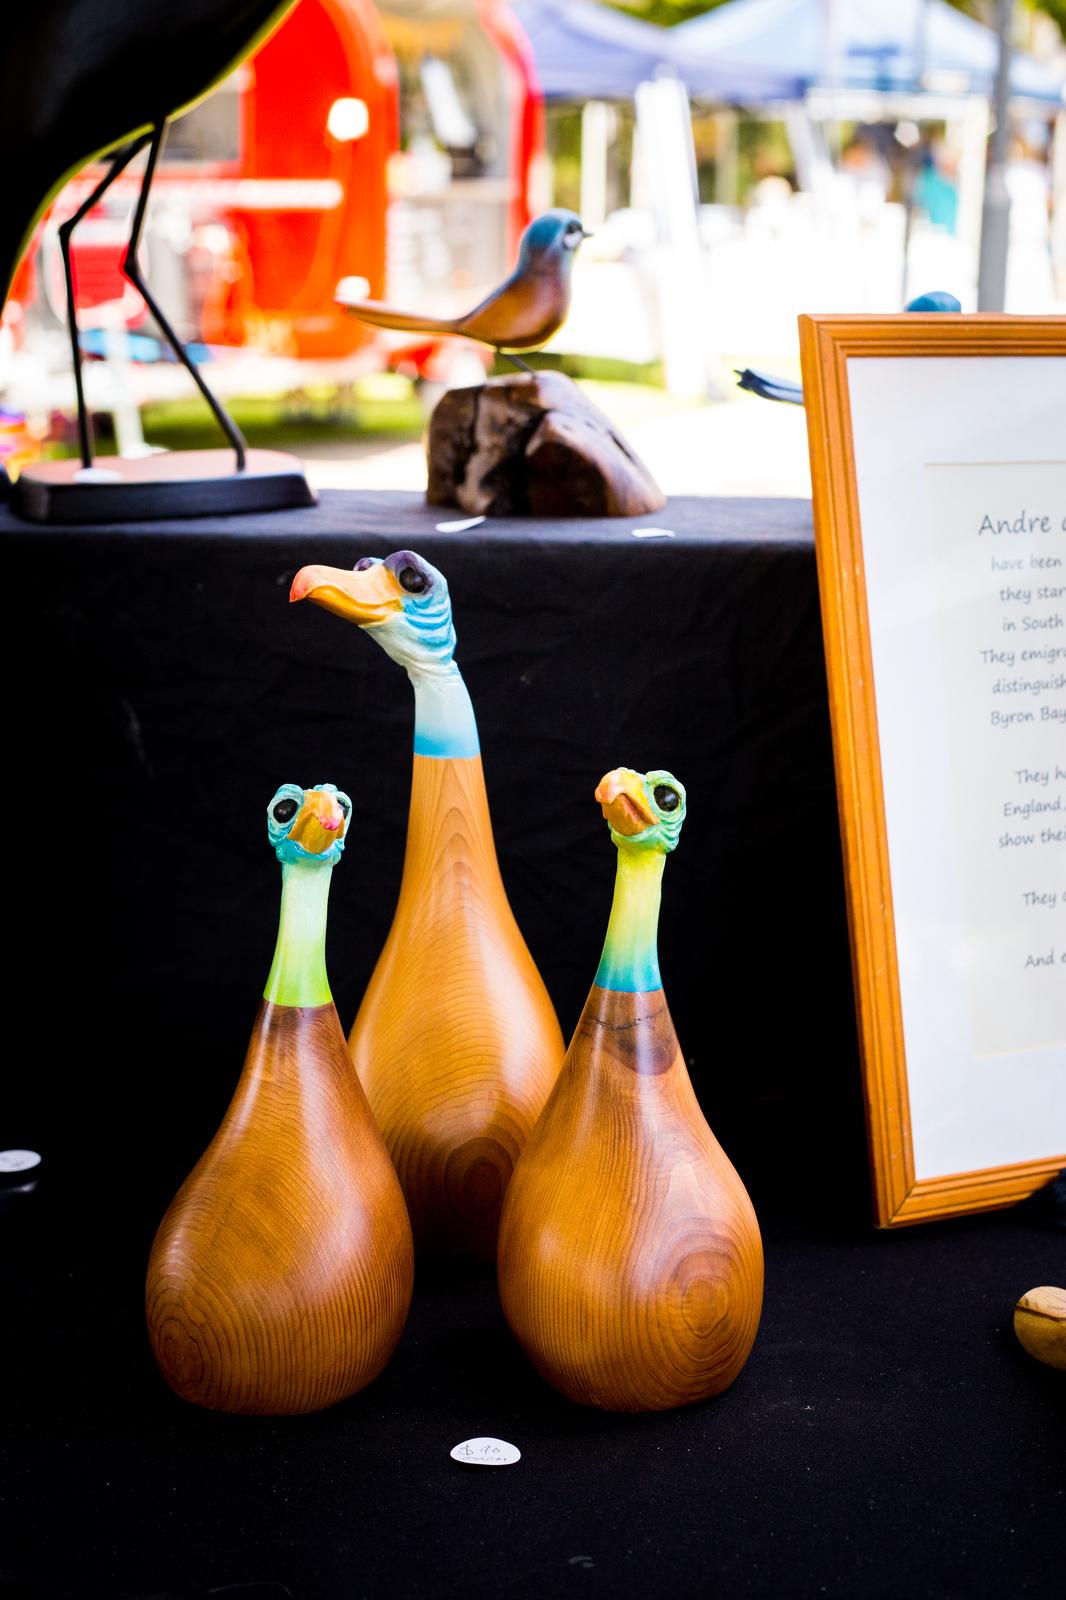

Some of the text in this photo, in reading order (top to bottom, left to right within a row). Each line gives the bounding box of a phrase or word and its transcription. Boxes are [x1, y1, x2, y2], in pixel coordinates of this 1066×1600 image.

[978, 509, 1052, 536] Andre
[991, 553, 1063, 571] have been
[999, 586, 1032, 605] they
[1002, 614, 1064, 632] in South
[980, 649, 1015, 667] They
[991, 706, 1066, 729] Byron Bay
[1014, 768, 1050, 787] They
[998, 832, 1035, 849] show
[1022, 890, 1057, 909] They
[1024, 949, 1056, 968] And
